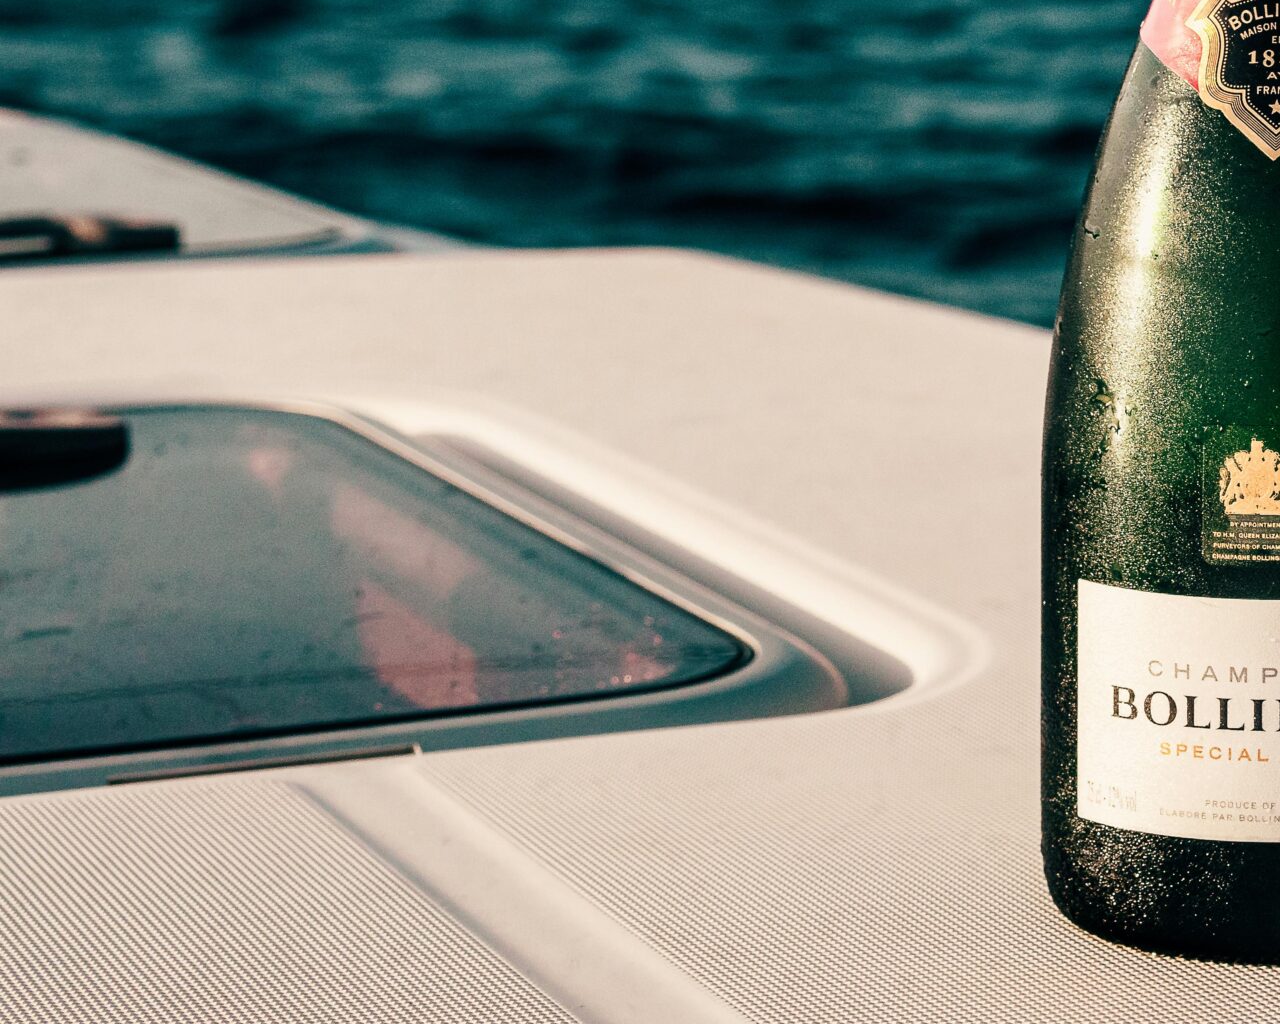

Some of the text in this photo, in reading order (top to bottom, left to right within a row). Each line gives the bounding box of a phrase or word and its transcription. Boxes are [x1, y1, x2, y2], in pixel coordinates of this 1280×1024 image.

[1240, 21, 1277, 40] MAISON
[1159, 742, 1269, 763] SPECIAL
[1204, 799, 1257, 810] PRODUCE
[1262, 802, 1276, 810] OF
[1212, 813, 1233, 821] PAR
